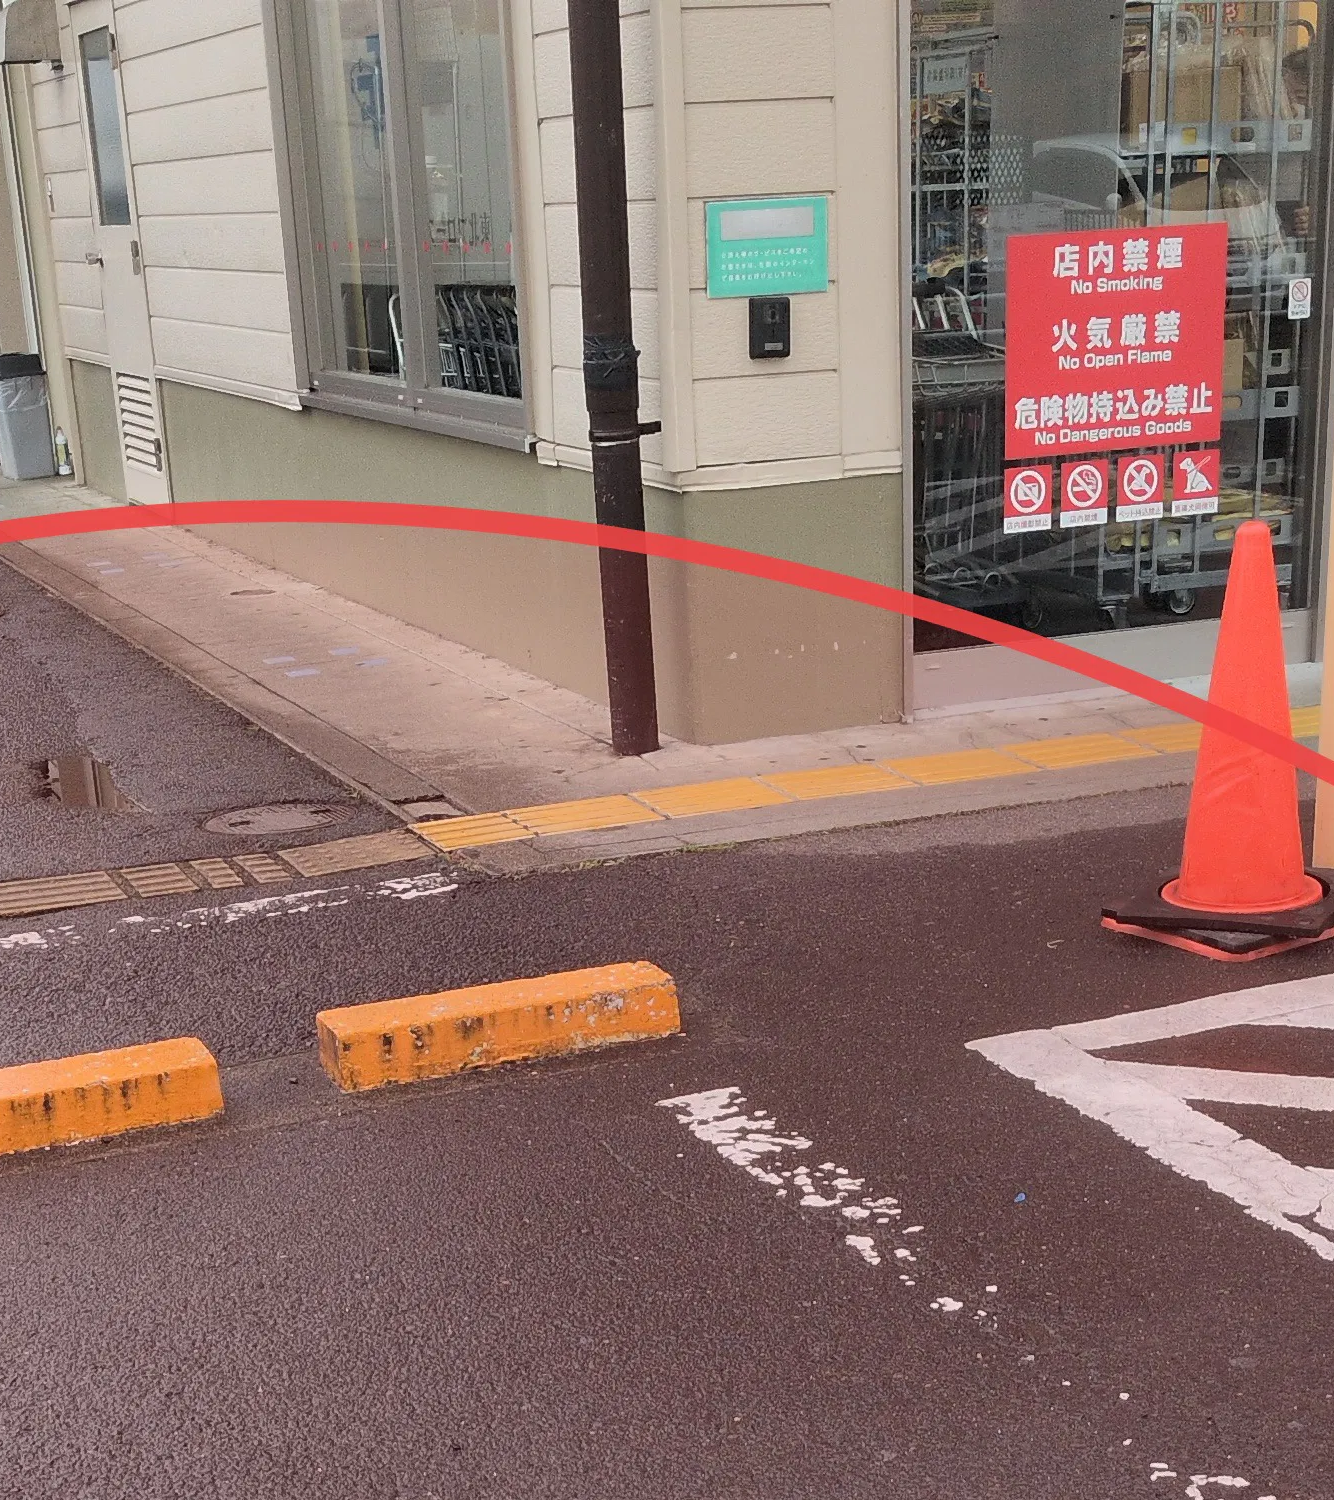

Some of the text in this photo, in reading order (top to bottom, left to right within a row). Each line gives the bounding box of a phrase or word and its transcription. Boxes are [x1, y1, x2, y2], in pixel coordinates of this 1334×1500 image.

[1053, 237, 1184, 278] 店内禁煙
[1070, 276, 1164, 294] No Smoking
[1051, 310, 1181, 353] 火気厳禁
[1059, 348, 1172, 370] No Open Flame
[1014, 381, 1213, 430] 危険物持込み禁止
[1035, 418, 1192, 445] No Dangerous Goods
